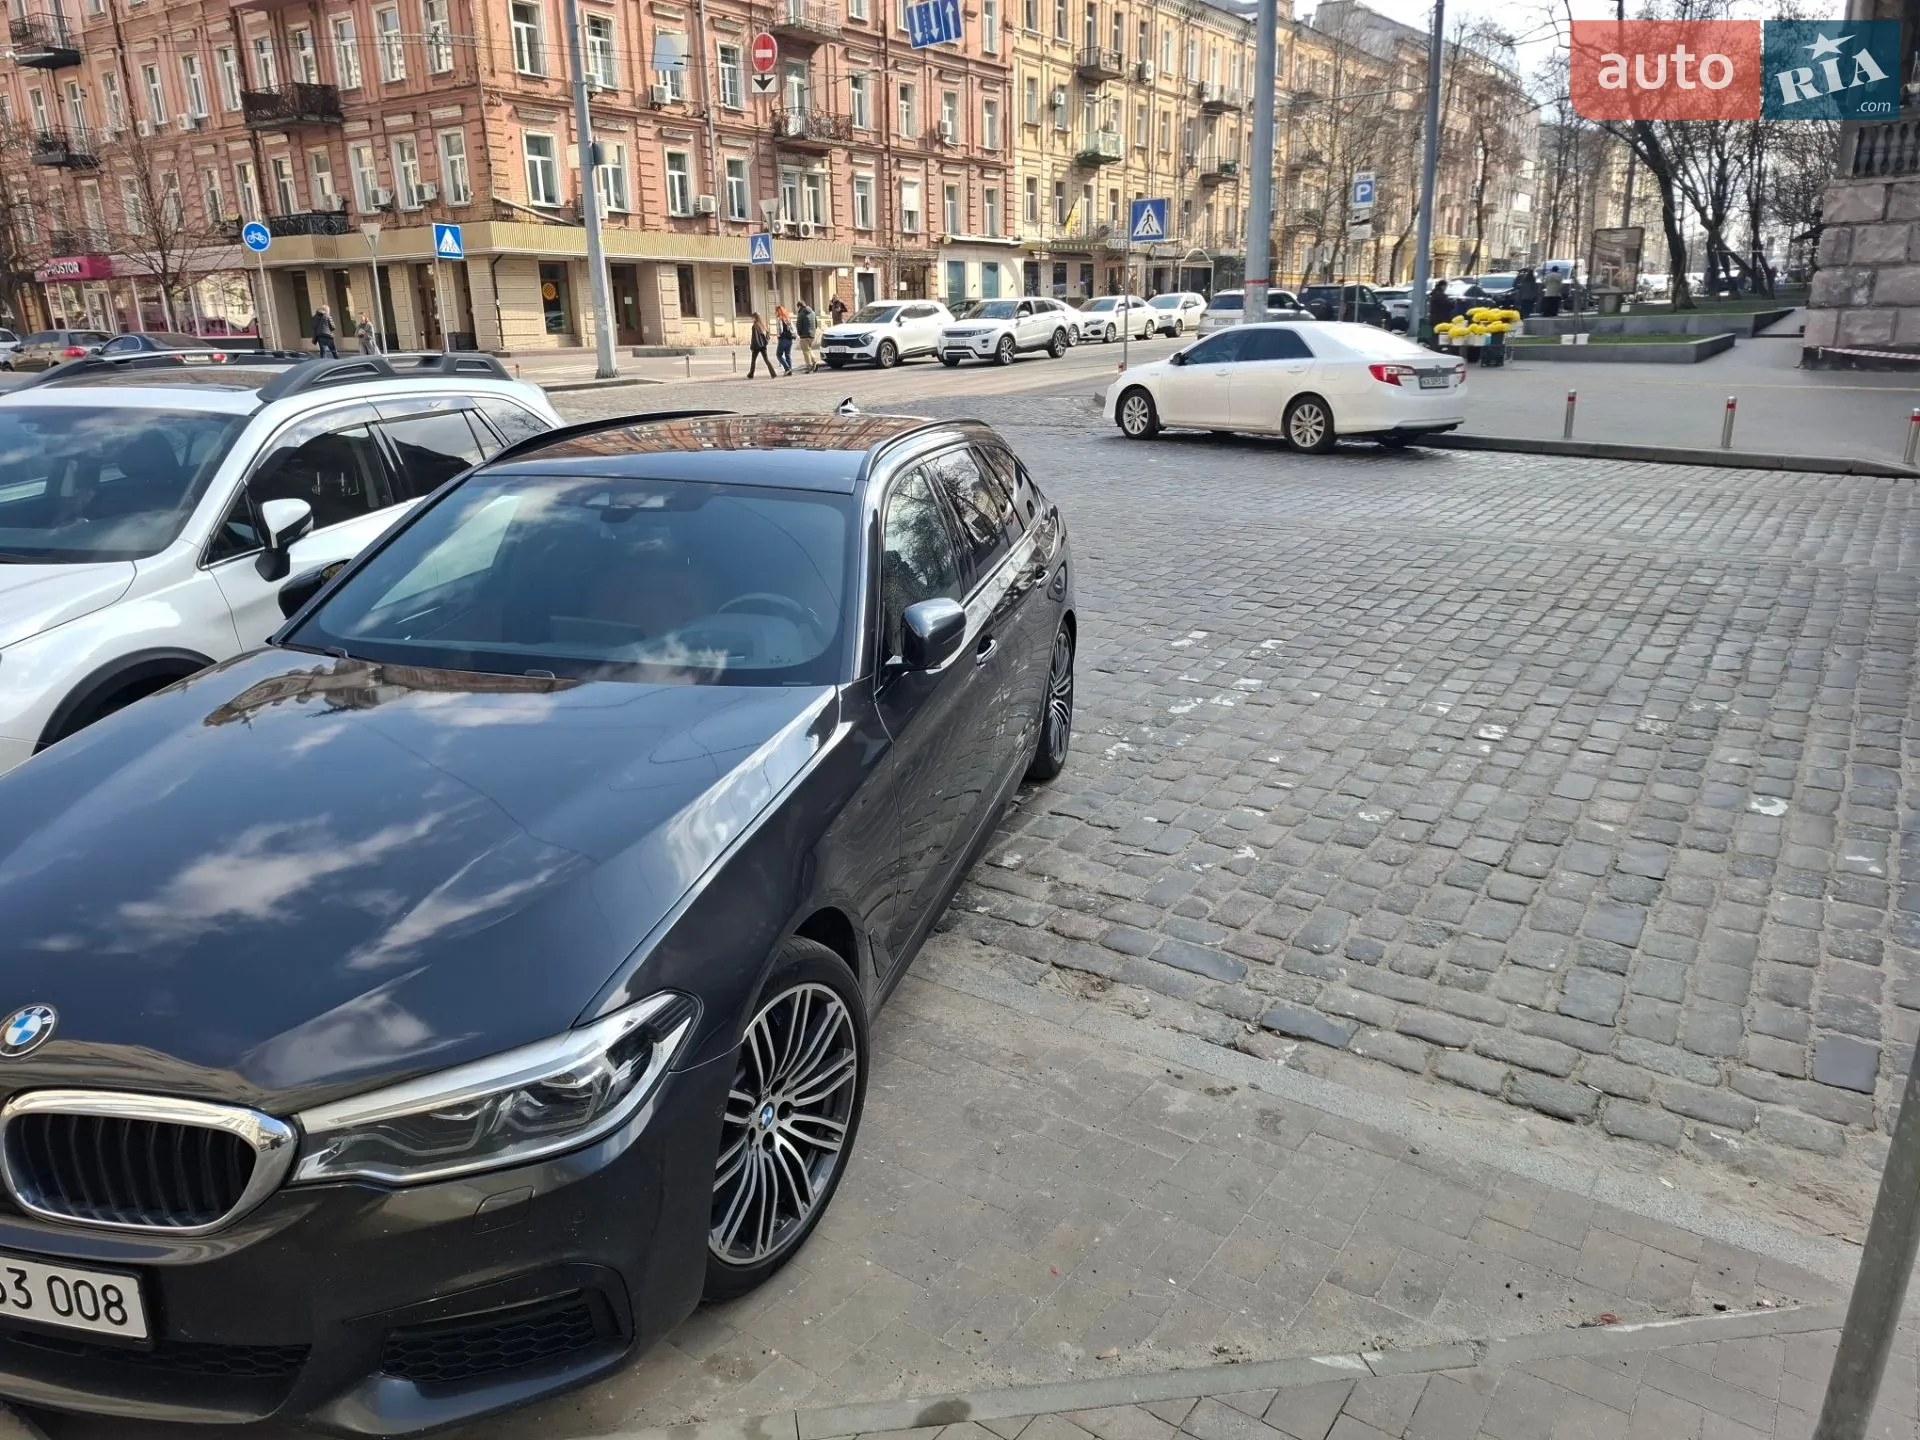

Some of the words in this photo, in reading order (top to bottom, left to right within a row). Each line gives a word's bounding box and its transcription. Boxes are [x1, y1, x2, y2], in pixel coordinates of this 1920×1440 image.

[1356, 183, 1371, 201] P
[0, 1266, 33, 1310] 3
[46, 1274, 128, 1326] 008
